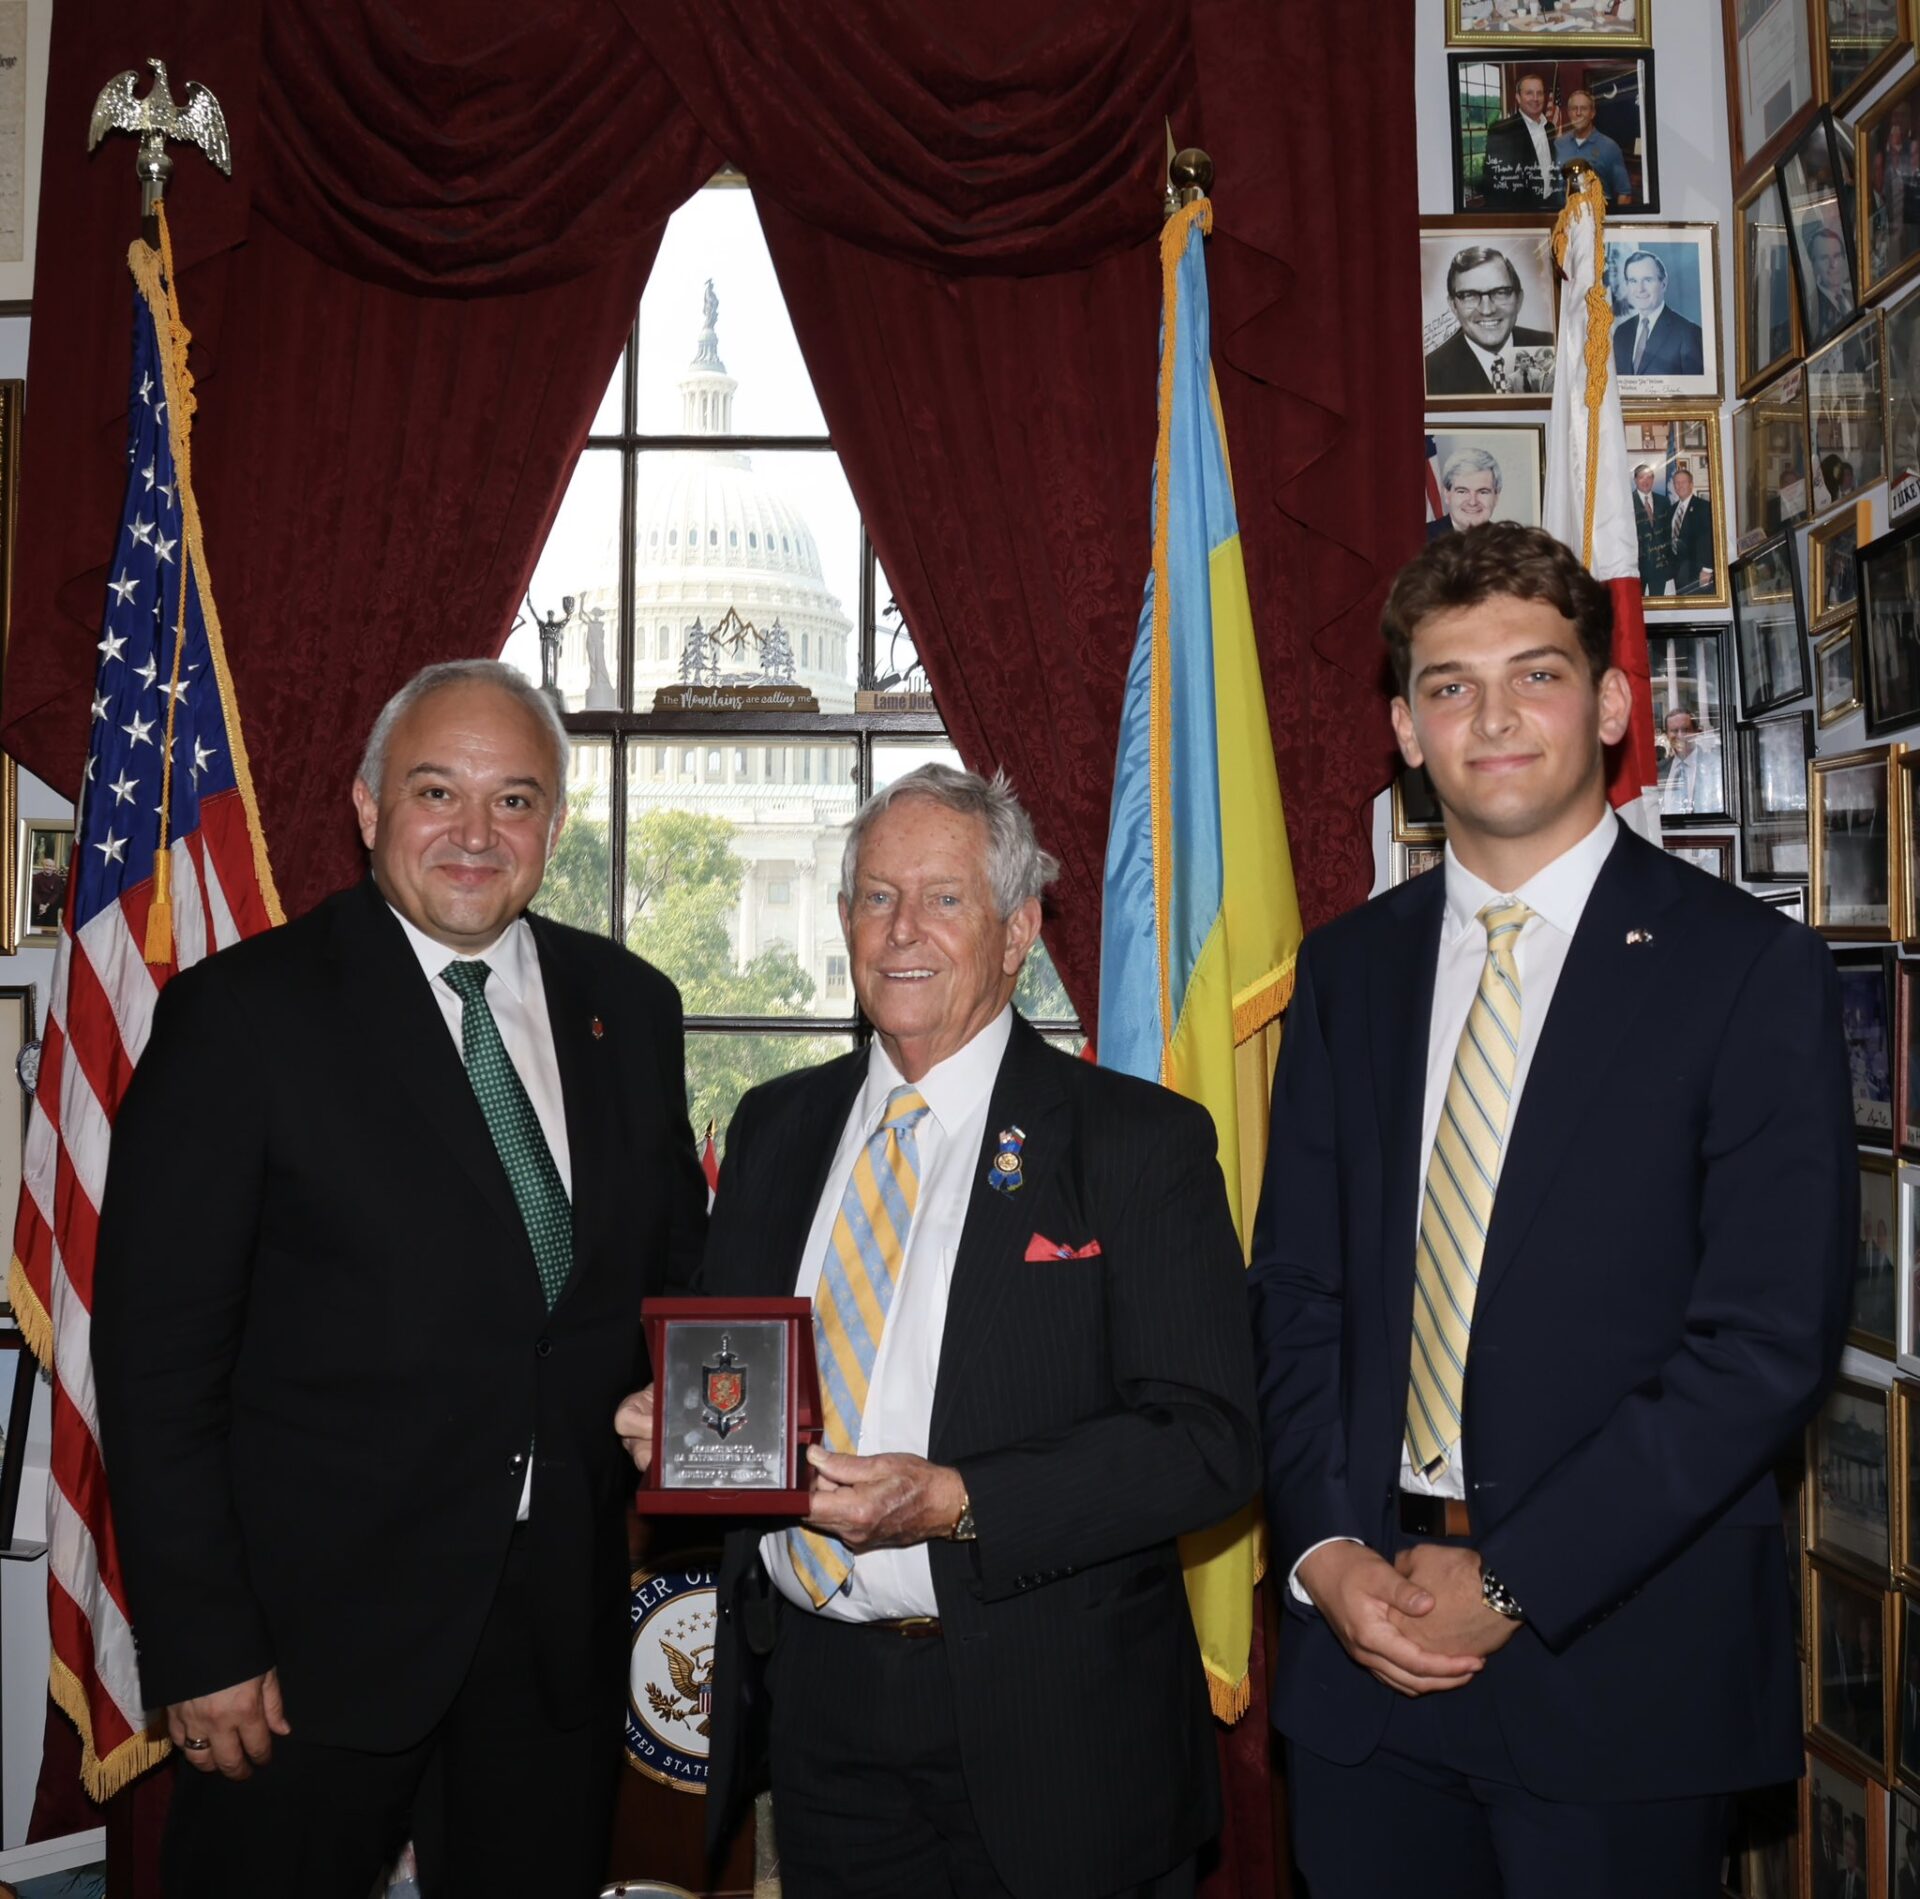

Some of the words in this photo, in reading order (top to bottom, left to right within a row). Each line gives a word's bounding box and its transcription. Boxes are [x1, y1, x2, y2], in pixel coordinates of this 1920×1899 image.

[663, 695, 679, 705] The
[680, 687, 744, 710] Mountains
[761, 691, 795, 708] calling
[873, 693, 907, 710] Lame
[631, 1575, 673, 1623] BER
[626, 1726, 655, 1756] ITED
